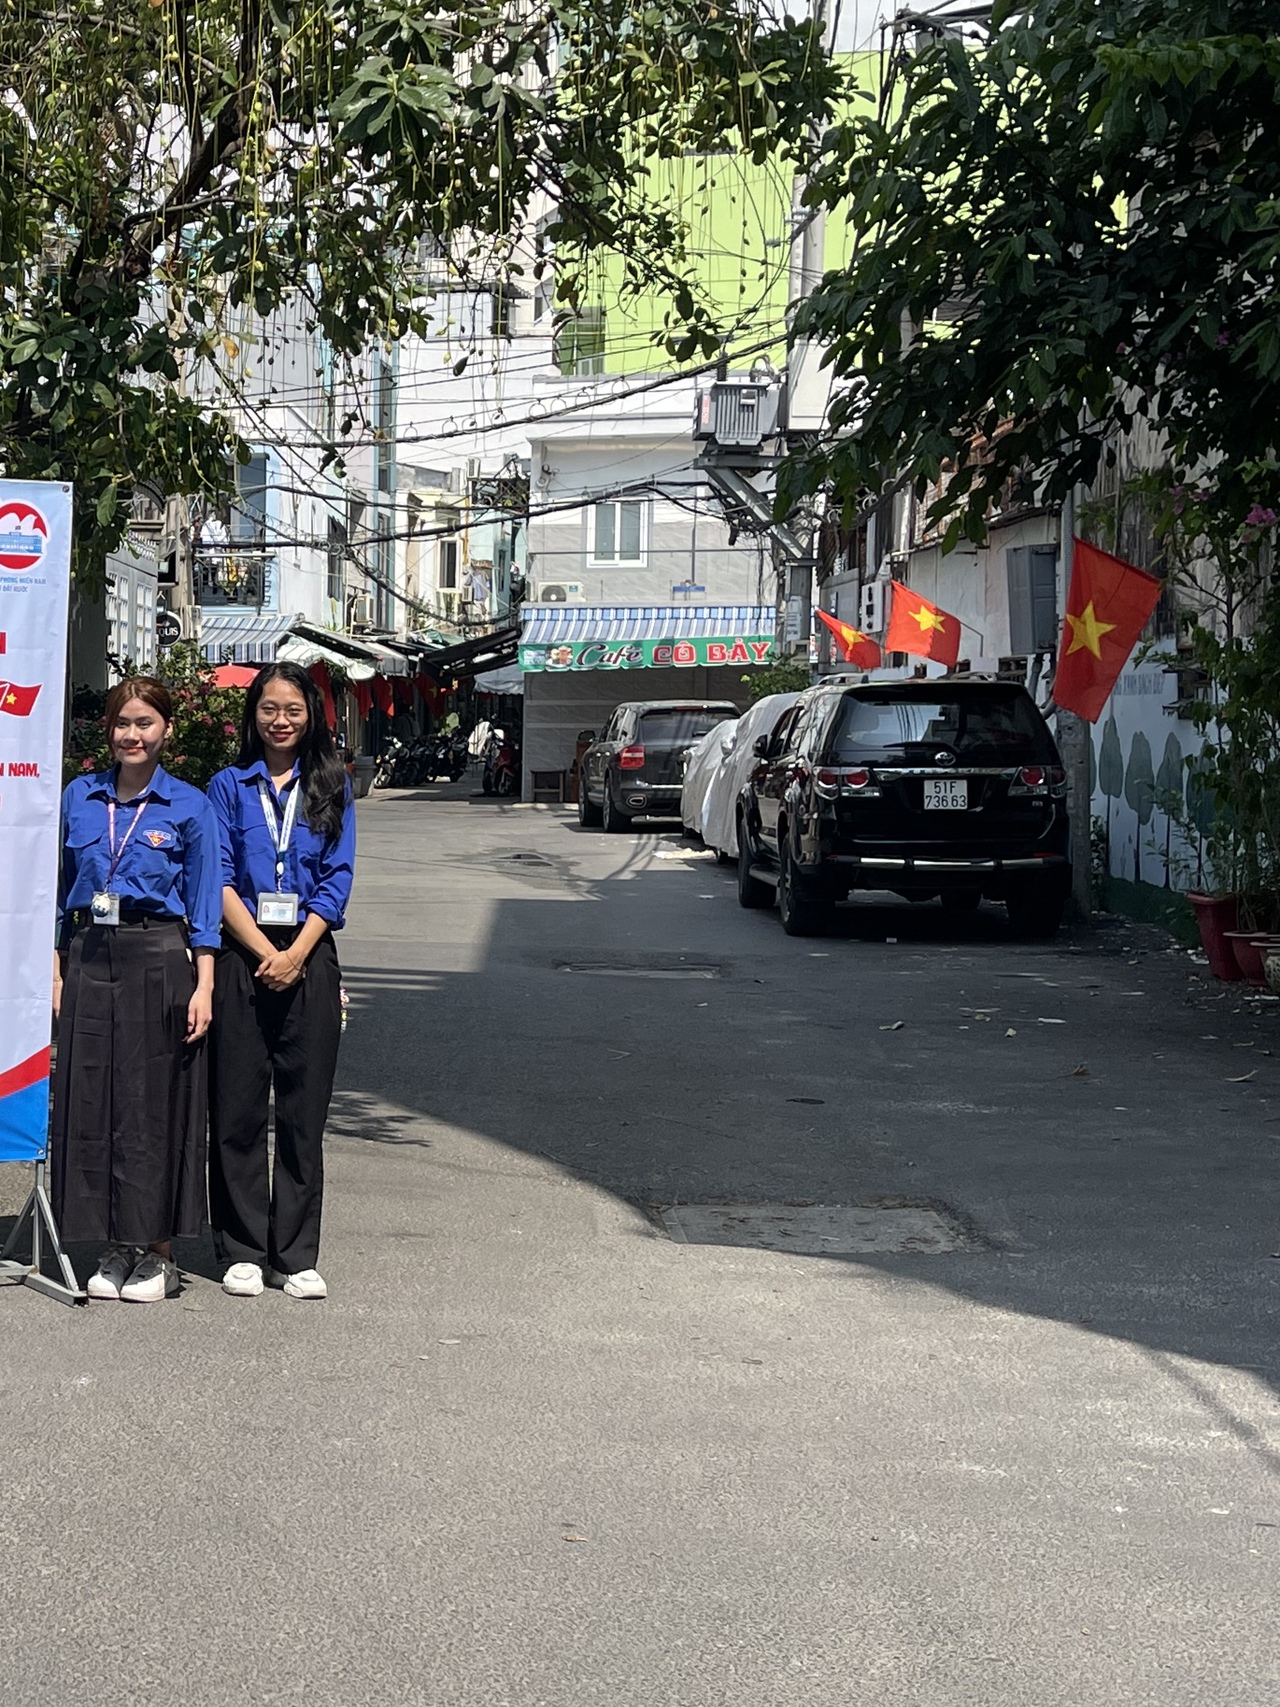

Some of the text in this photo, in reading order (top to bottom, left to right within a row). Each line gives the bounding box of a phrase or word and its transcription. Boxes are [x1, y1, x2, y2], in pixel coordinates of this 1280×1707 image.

[653, 641, 696, 664] CÔ
[706, 638, 771, 662] BẢY
[8, 763, 41, 779] NAM,
[933, 781, 957, 794] 51F
